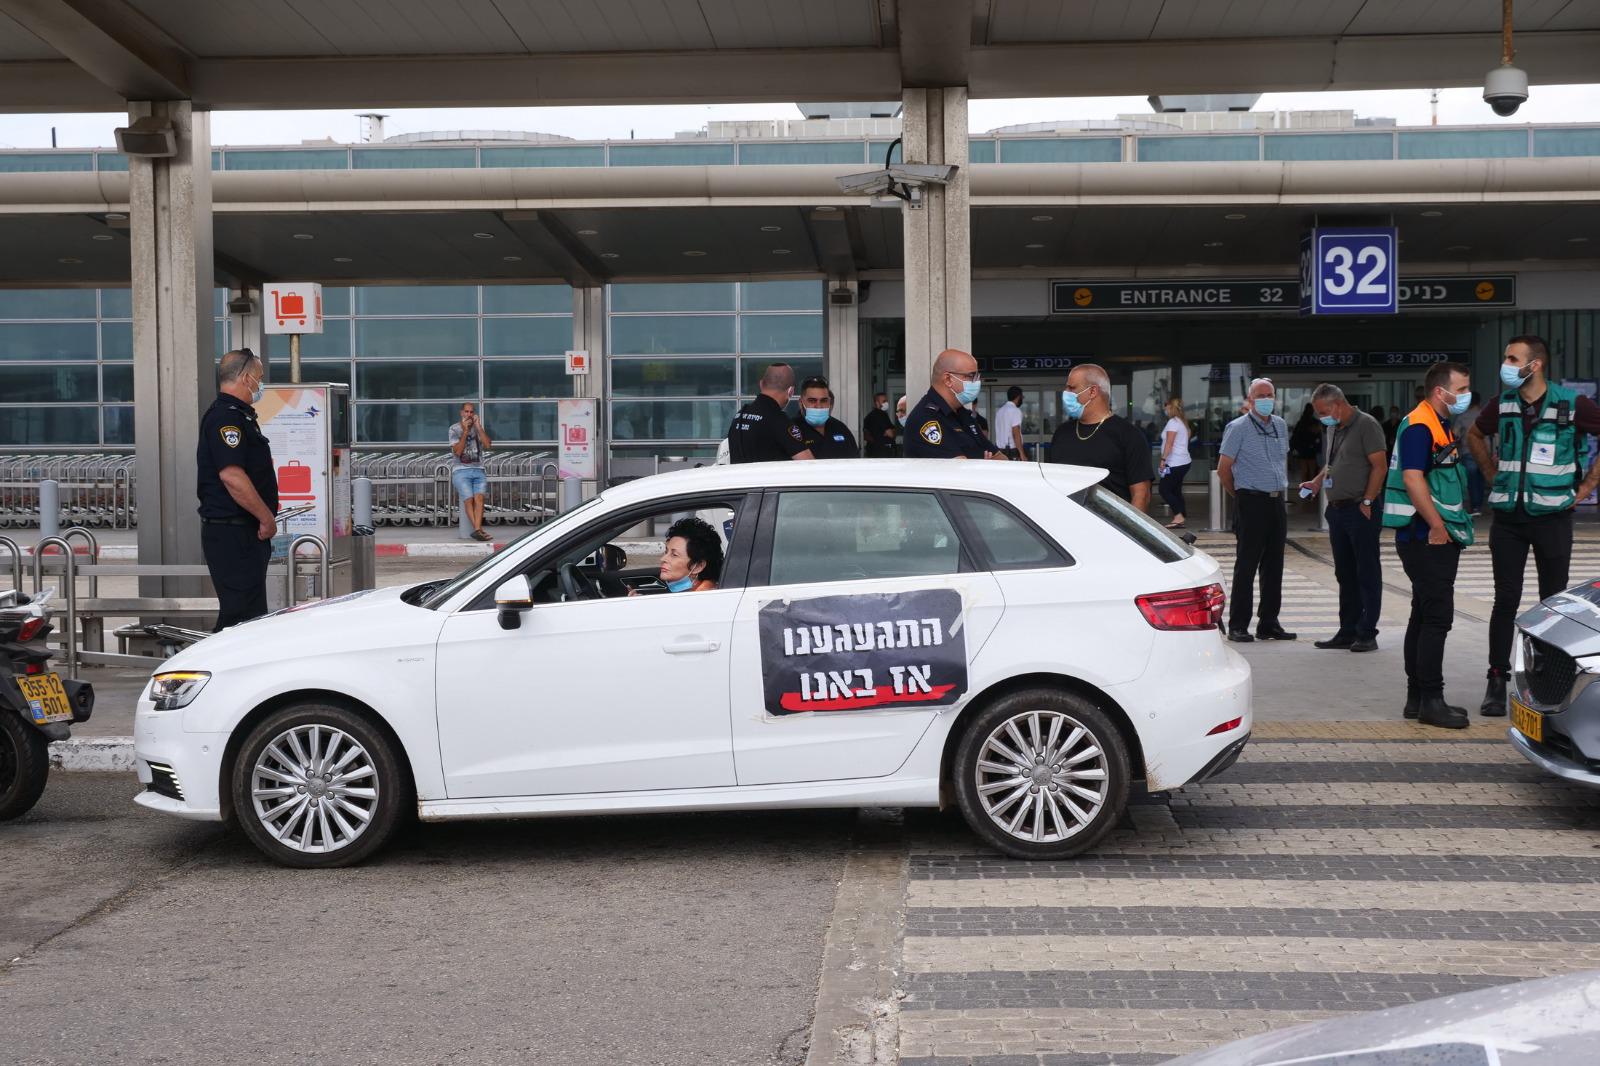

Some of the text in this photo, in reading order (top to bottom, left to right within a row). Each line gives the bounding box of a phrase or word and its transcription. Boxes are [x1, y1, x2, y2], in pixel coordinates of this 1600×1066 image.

[1323, 245, 1388, 296] 32
[1120, 287, 1284, 304] ENTRANCE 32
[1398, 285, 1448, 301] כניס
[1011, 358, 1072, 369] כניסה 32
[1266, 354, 1354, 366] ENTRANCE 32
[1386, 353, 1449, 364] כניסה 32
[783, 617, 944, 656] התגעגענו
[800, 664, 933, 701] אז באנו
[43, 696, 65, 715] 501
